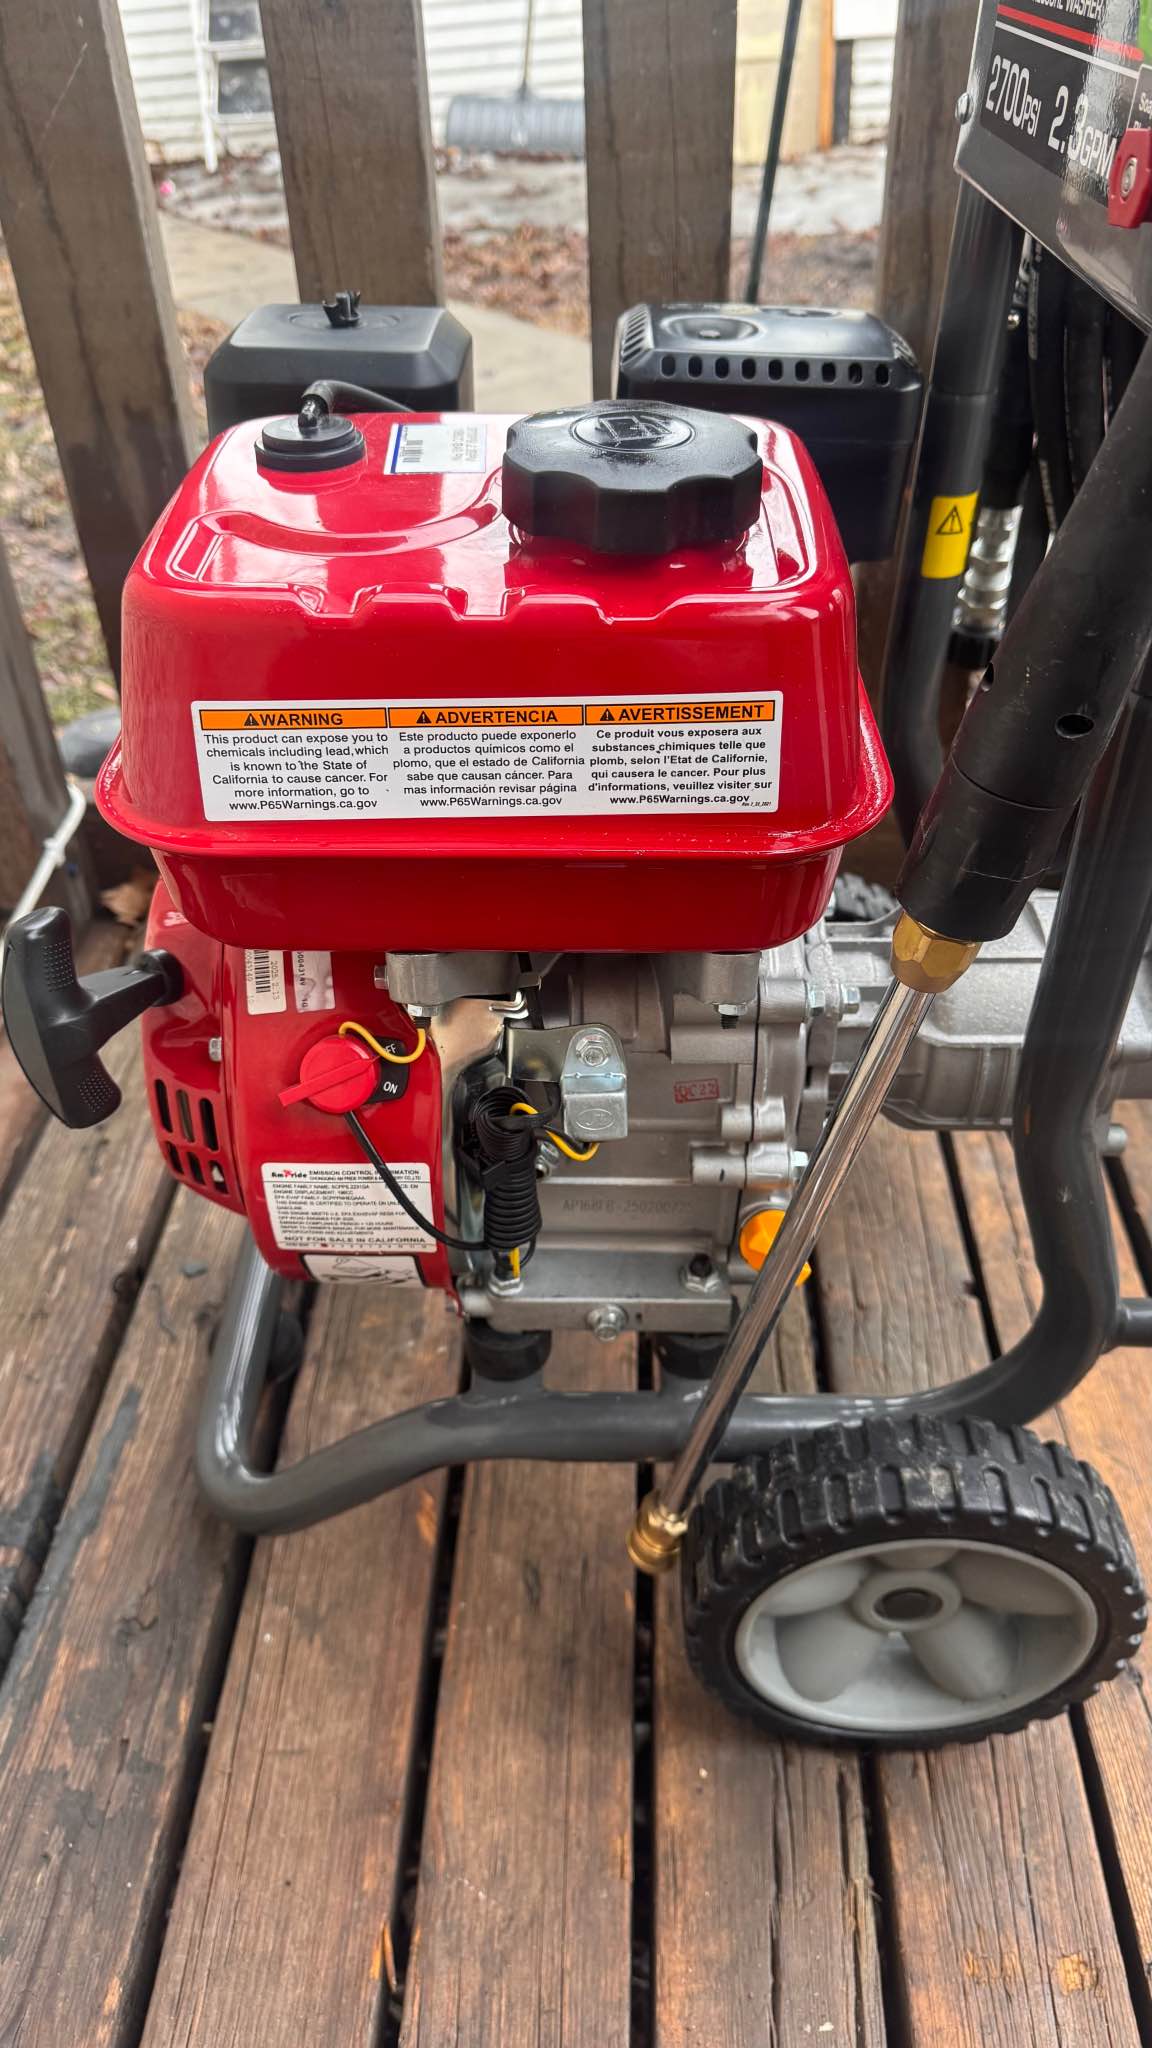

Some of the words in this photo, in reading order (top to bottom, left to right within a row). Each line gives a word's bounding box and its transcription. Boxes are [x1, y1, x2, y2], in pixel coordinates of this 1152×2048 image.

[436, 710, 558, 723] ADVERTENCIA
[618, 704, 765, 721] AVERTISSEMENT
[260, 713, 343, 726] WARNING
[204, 735, 228, 743] This
[233, 735, 278, 746] product
[307, 735, 348, 744] expose
[352, 735, 373, 744] you
[377, 733, 387, 741] to
[400, 732, 423, 741] Este
[428, 732, 477, 742] producto
[482, 731, 516, 742] puede
[521, 730, 576, 741] exponerlo
[597, 730, 611, 738] Ce
[615, 729, 654, 740] produit
[688, 729, 738, 738] exposera
[414, 745, 470, 756] productos
[475, 744, 525, 755] químicos
[565, 743, 573, 752] el
[658, 741, 715, 751] chimiques
[719, 741, 741, 749] telle
[746, 742, 765, 750] que
[207, 748, 265, 757] chemicals
[269, 747, 322, 758] including
[231, 762, 240, 771] is
[244, 762, 281, 770] known
[286, 762, 296, 770] to
[300, 761, 318, 770] the
[323, 761, 352, 770] State
[356, 760, 367, 769] of
[393, 759, 431, 769] plomo,
[435, 760, 455, 769] que
[460, 758, 468, 766] el
[473, 758, 510, 766] estado
[514, 758, 527, 766] de
[532, 756, 584, 765] California
[590, 757, 627, 767] plomb,
[631, 756, 660, 764] selon
[695, 755, 708, 763] de
[712, 754, 767, 762] Californie,
[213, 775, 268, 784] California
[272, 775, 283, 783] to
[370, 773, 387, 781] For
[407, 772, 433, 780] sabe
[438, 774, 458, 782] que
[505, 771, 544, 779] cáncer.
[548, 771, 572, 779] Para
[592, 770, 607, 780] qui
[658, 769, 667, 777] le
[714, 768, 739, 776] Pour
[743, 767, 765, 777] plus
[431, 785, 495, 793] información
[499, 784, 536, 793] revisar
[540, 784, 576, 794] página
[589, 783, 669, 791] d'informations,
[718, 781, 751, 789] visiter
[268, 787, 336, 796] information,
[340, 788, 354, 797] go
[358, 787, 369, 795] to
[229, 800, 377, 810] www.P65Warnings.ca.gov
[420, 797, 561, 807] www.P65Warnings.ca.gov
[610, 795, 749, 806] www.P65Warnings.ca.gov
[383, 1081, 398, 1094] ON
